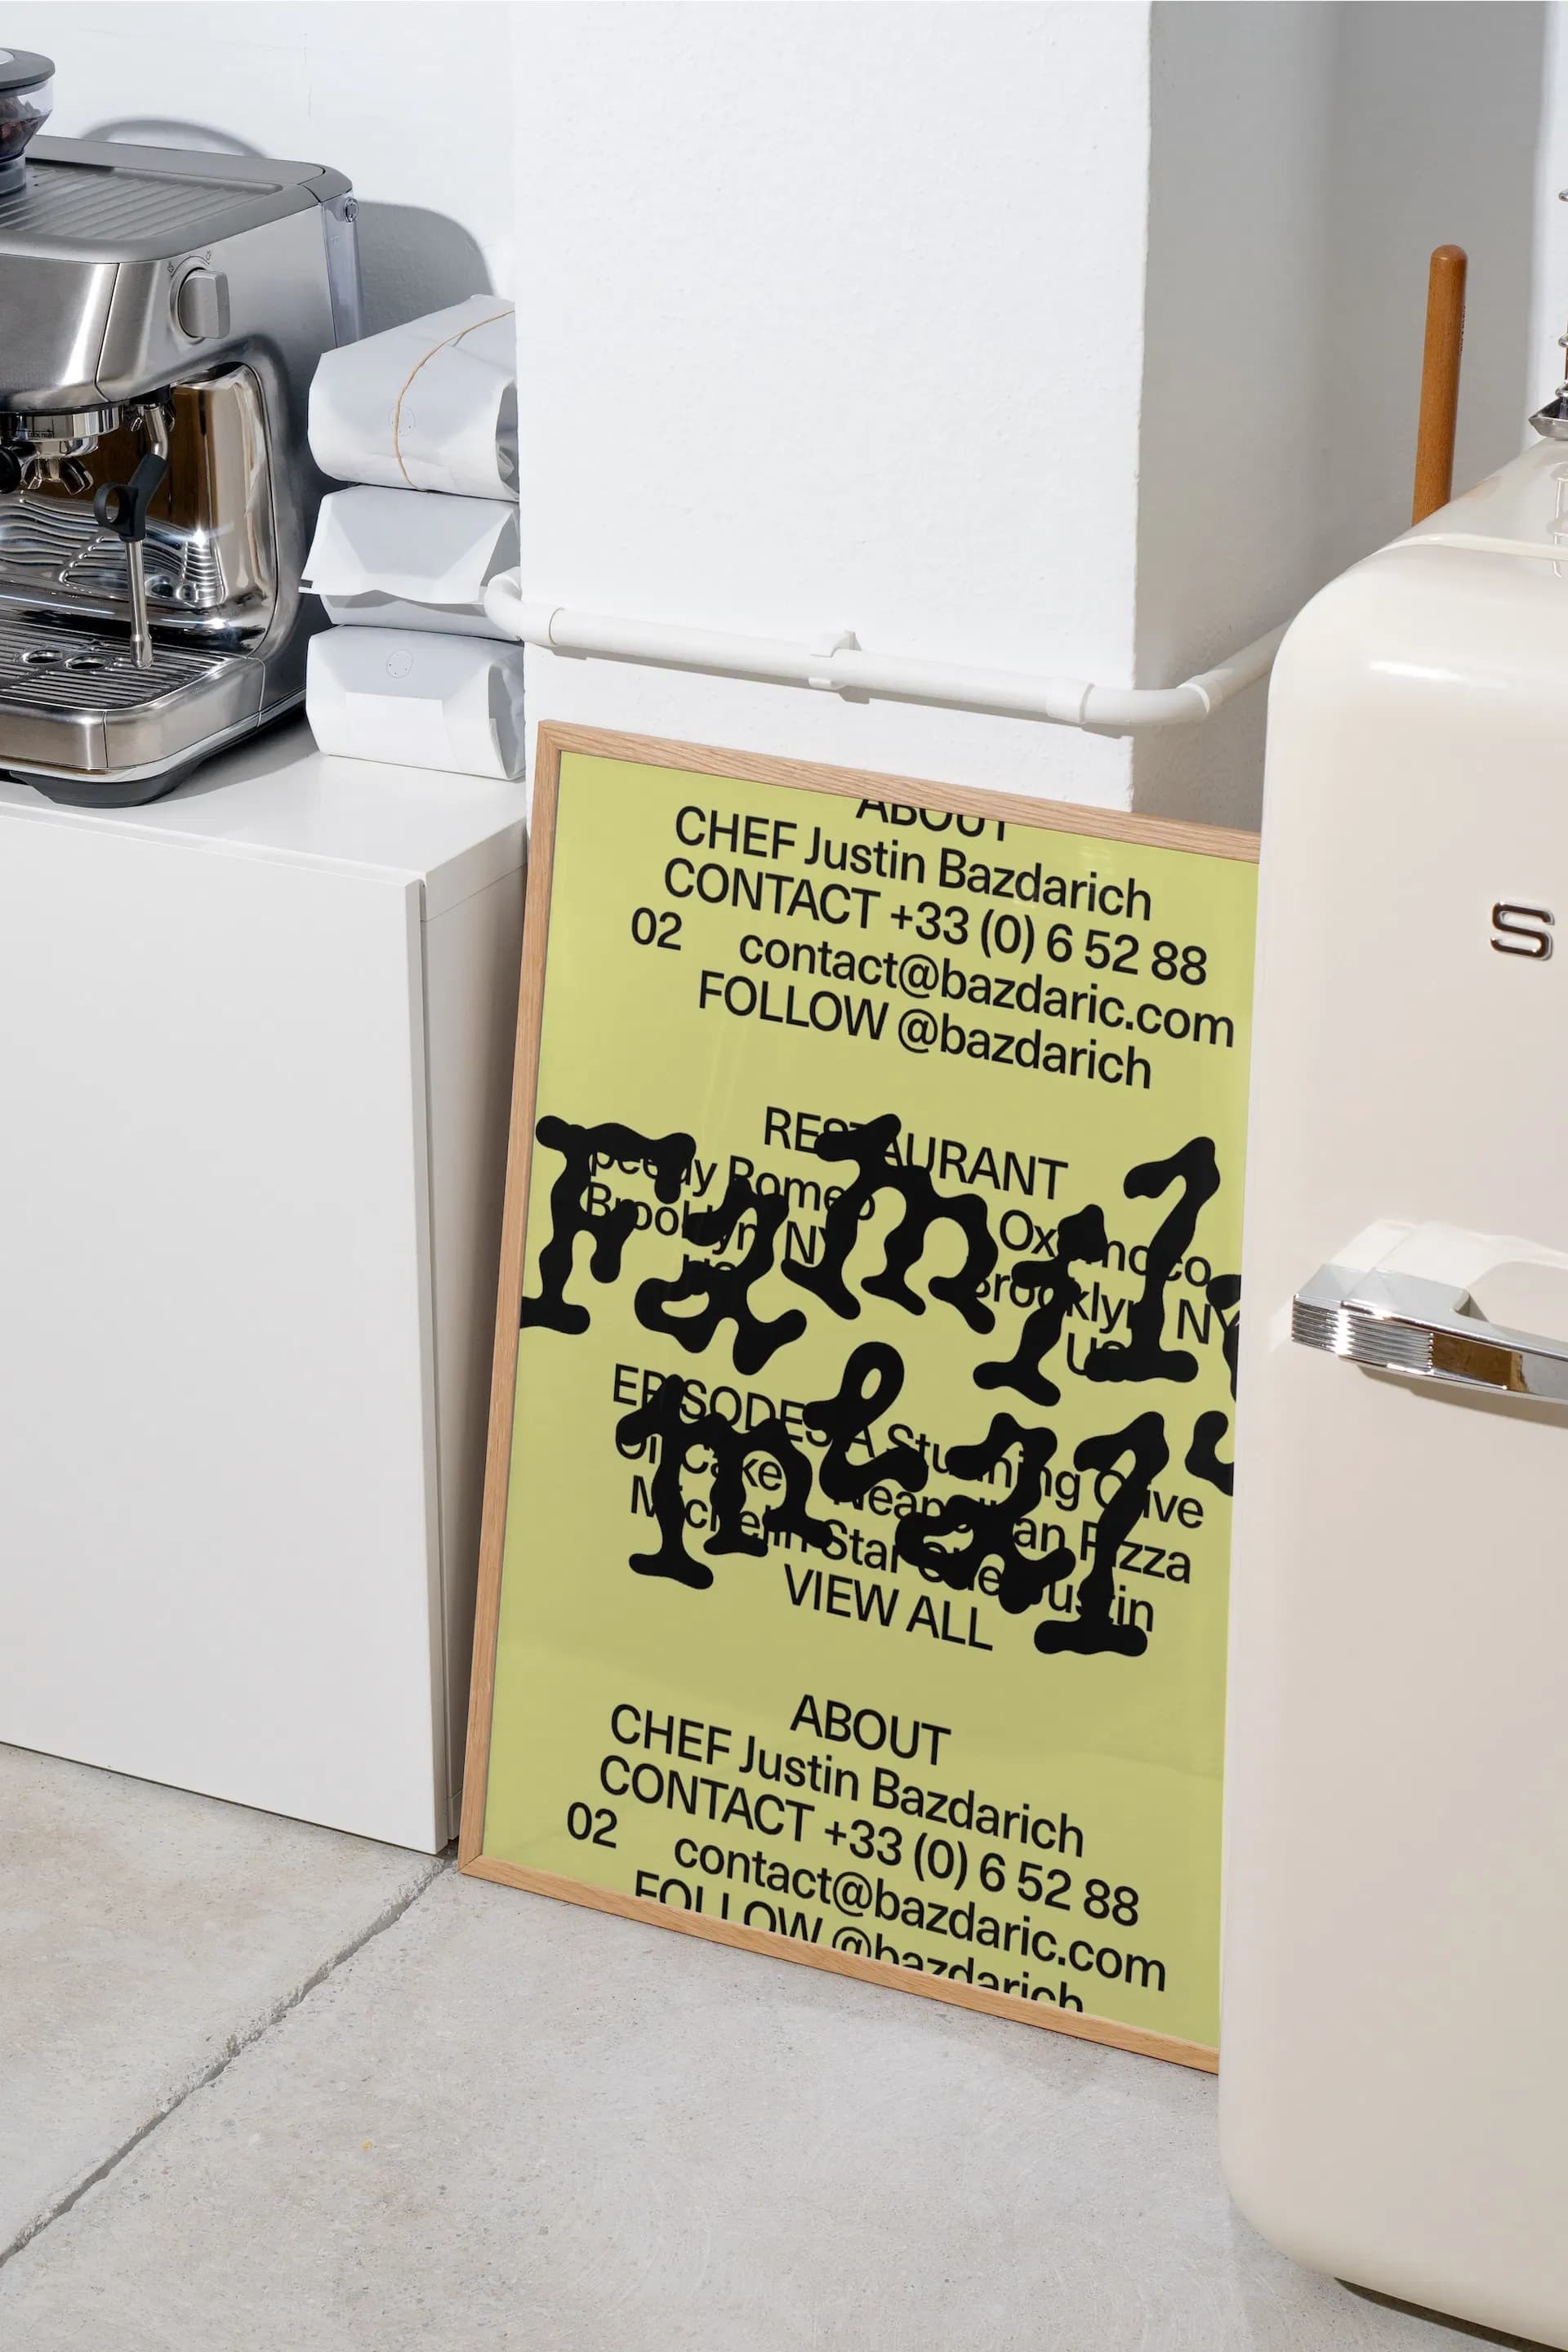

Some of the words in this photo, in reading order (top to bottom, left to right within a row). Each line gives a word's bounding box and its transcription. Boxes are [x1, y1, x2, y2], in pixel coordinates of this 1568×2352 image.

[665, 858, 881, 929] CONTACT
[890, 901, 969, 945] +33
[981, 908, 1035, 964] (0)
[1046, 923, 1073, 963] 6
[1085, 929, 1139, 975] 52
[1151, 940, 1207, 986] 88
[675, 805, 798, 860] CHEF
[804, 826, 925, 884] Justin
[938, 847, 1152, 921] Bazdarich
[631, 906, 682, 951] 02
[739, 934, 1234, 1048] contact@bazdaric.com
[699, 969, 889, 1040] FOLLOW
[898, 1008, 1151, 1089] @bazdarich
[764, 1106, 1069, 1200] REAURANT
[612, 1362, 832, 1448] EPSODE
[887, 1423, 1081, 1512] Stunng
[1094, 1469, 1204, 1529] Oive
[783, 1562, 900, 1628] VIEW
[905, 1594, 993, 1651] ALL
[1080, 1520, 1191, 1584] Pzza
[611, 1704, 732, 1766] CHEF
[738, 1735, 859, 1802] Justin
[872, 1766, 1084, 1858] Bazdarich
[790, 1694, 951, 1766] ABOUT
[567, 1802, 617, 1849] 02
[674, 1838, 1166, 1992] contact@bazdaric.com
[600, 1754, 815, 1842] CONTACT
[824, 1819, 902, 1866] +33
[914, 1832, 968, 1891] (0)
[979, 1852, 1006, 1892] 6
[1018, 1860, 1071, 1911] 52
[1083, 1878, 1139, 1927] 88
